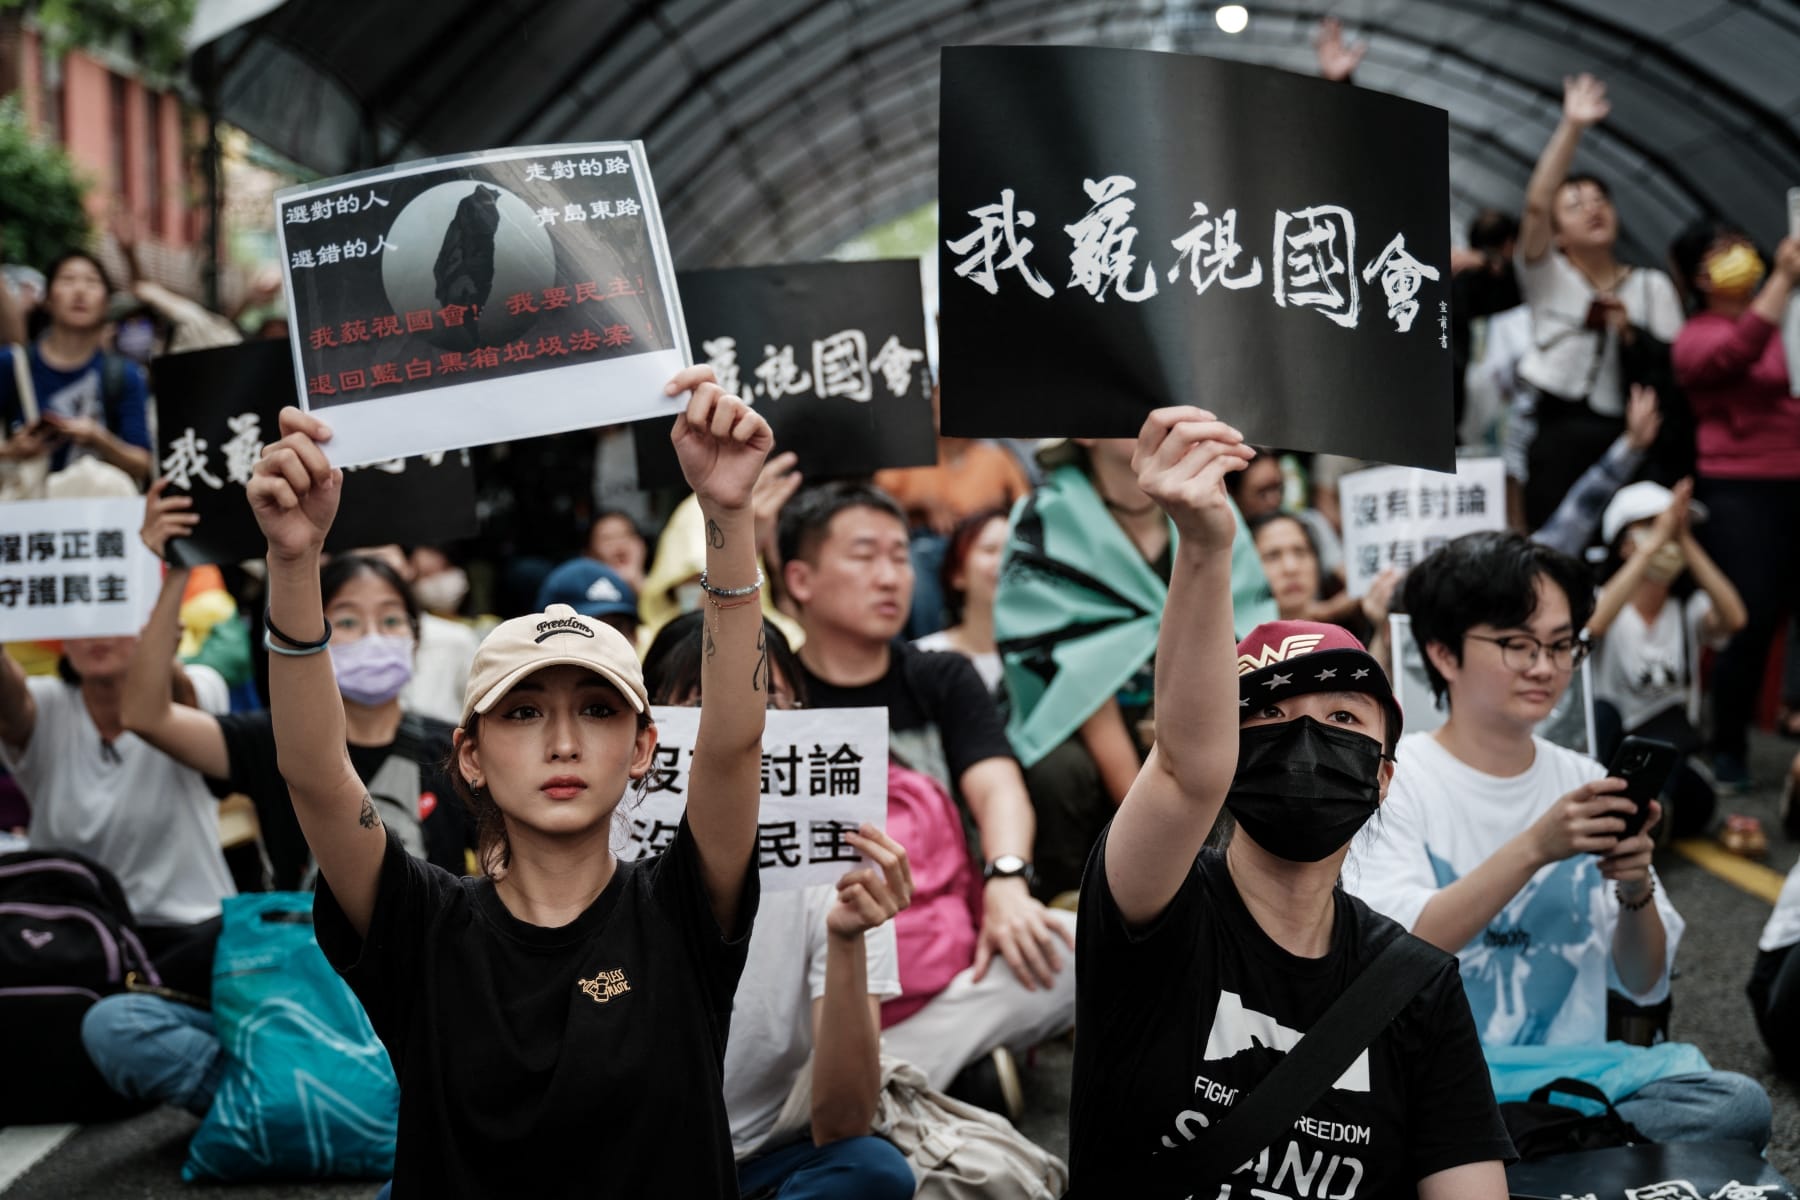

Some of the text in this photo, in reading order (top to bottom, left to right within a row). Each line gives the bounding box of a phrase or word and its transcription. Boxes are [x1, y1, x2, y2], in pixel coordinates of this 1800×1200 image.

[525, 156, 631, 182] 走對的路
[286, 190, 389, 225] 選對的人
[533, 197, 642, 227] 青島東路
[292, 234, 398, 270] 選錯的人
[945, 175, 1440, 333] 我藐視國會
[536, 616, 593, 637] Freedom
[1294, 1115, 1371, 1145] REEDOM
